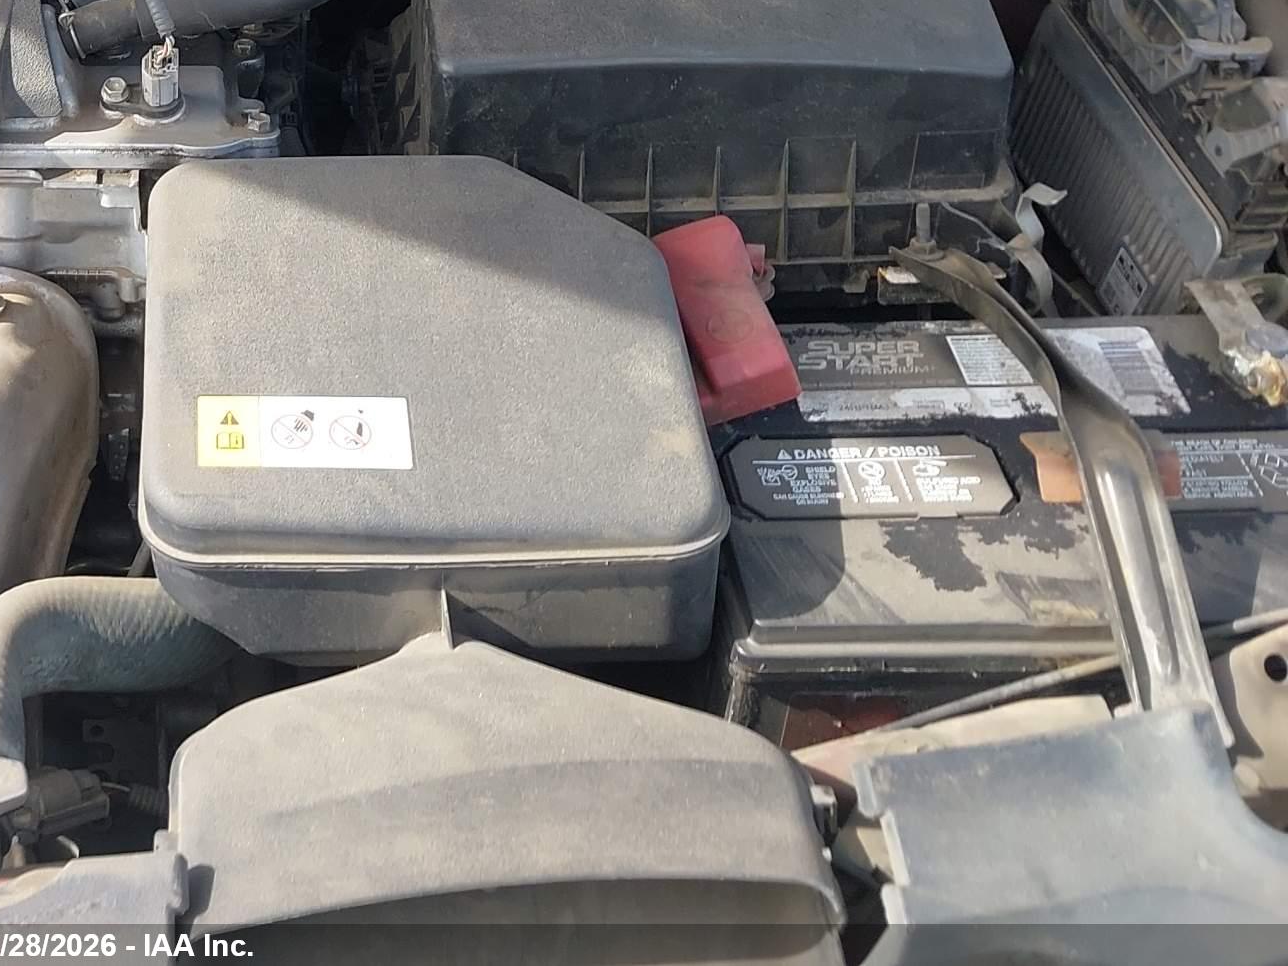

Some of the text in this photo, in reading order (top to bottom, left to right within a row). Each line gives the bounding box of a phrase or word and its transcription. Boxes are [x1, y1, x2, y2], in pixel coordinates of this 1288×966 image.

[807, 340, 920, 354] SUPER
[798, 353, 924, 371] START
[794, 447, 862, 459] DANGER
[878, 445, 941, 457] POISON
